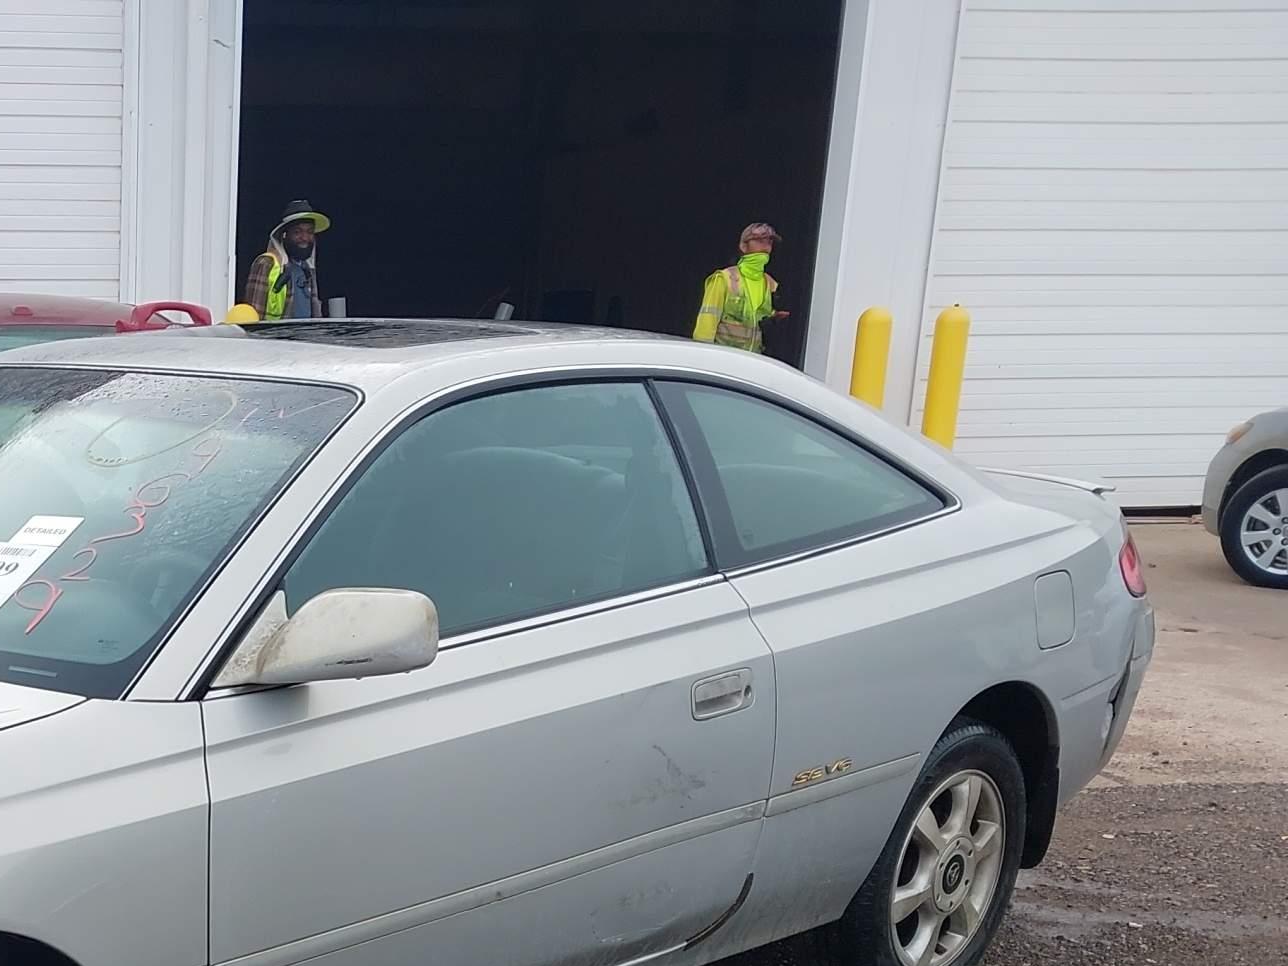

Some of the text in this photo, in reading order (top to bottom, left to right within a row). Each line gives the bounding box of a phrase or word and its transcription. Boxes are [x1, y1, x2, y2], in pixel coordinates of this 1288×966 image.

[23, 526, 67, 535] DETAILED
[792, 757, 852, 786] SE V6
